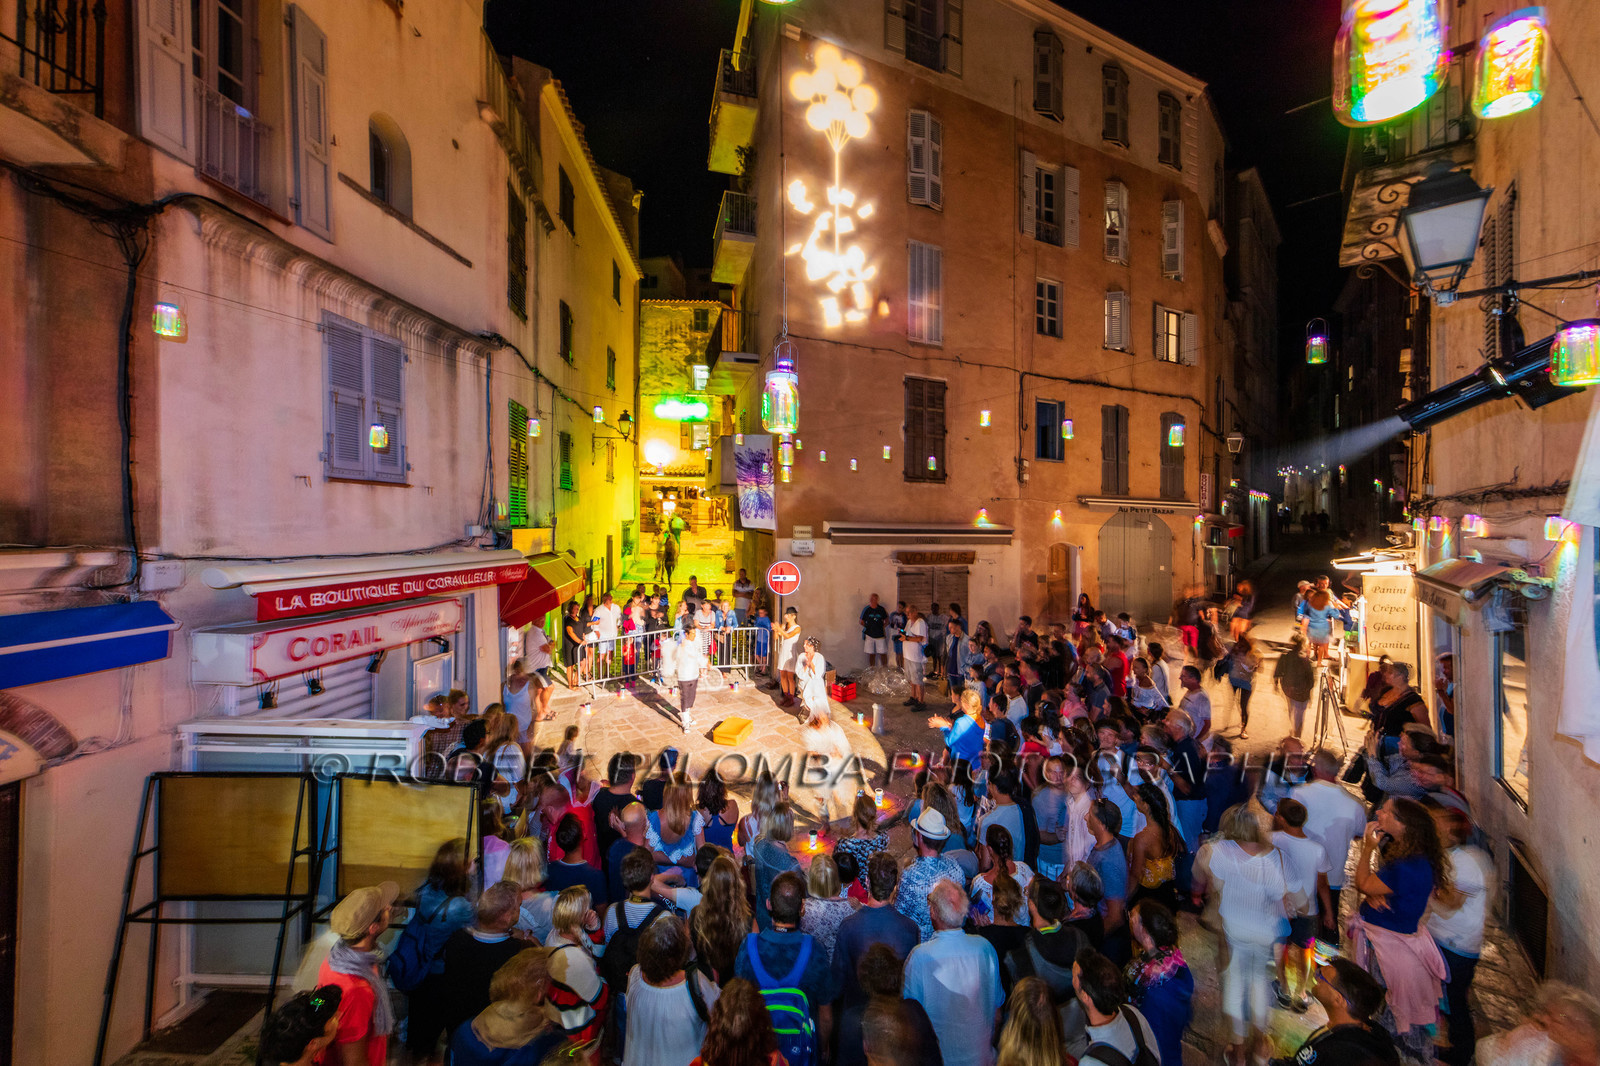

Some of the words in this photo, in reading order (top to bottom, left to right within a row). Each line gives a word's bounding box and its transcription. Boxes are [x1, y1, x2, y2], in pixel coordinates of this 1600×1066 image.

[904, 552, 968, 563] VOLUBILIS
[274, 594, 307, 612] LA
[309, 582, 401, 608] BOUTIQUE
[403, 578, 425, 594] DU
[425, 570, 497, 591] CORAILLEUR
[1371, 585, 1408, 595] Panini
[1372, 604, 1408, 615] Crêpes
[1372, 621, 1408, 633] Glaces
[286, 625, 385, 663] CORAIL
[1369, 640, 1411, 651] Granita
